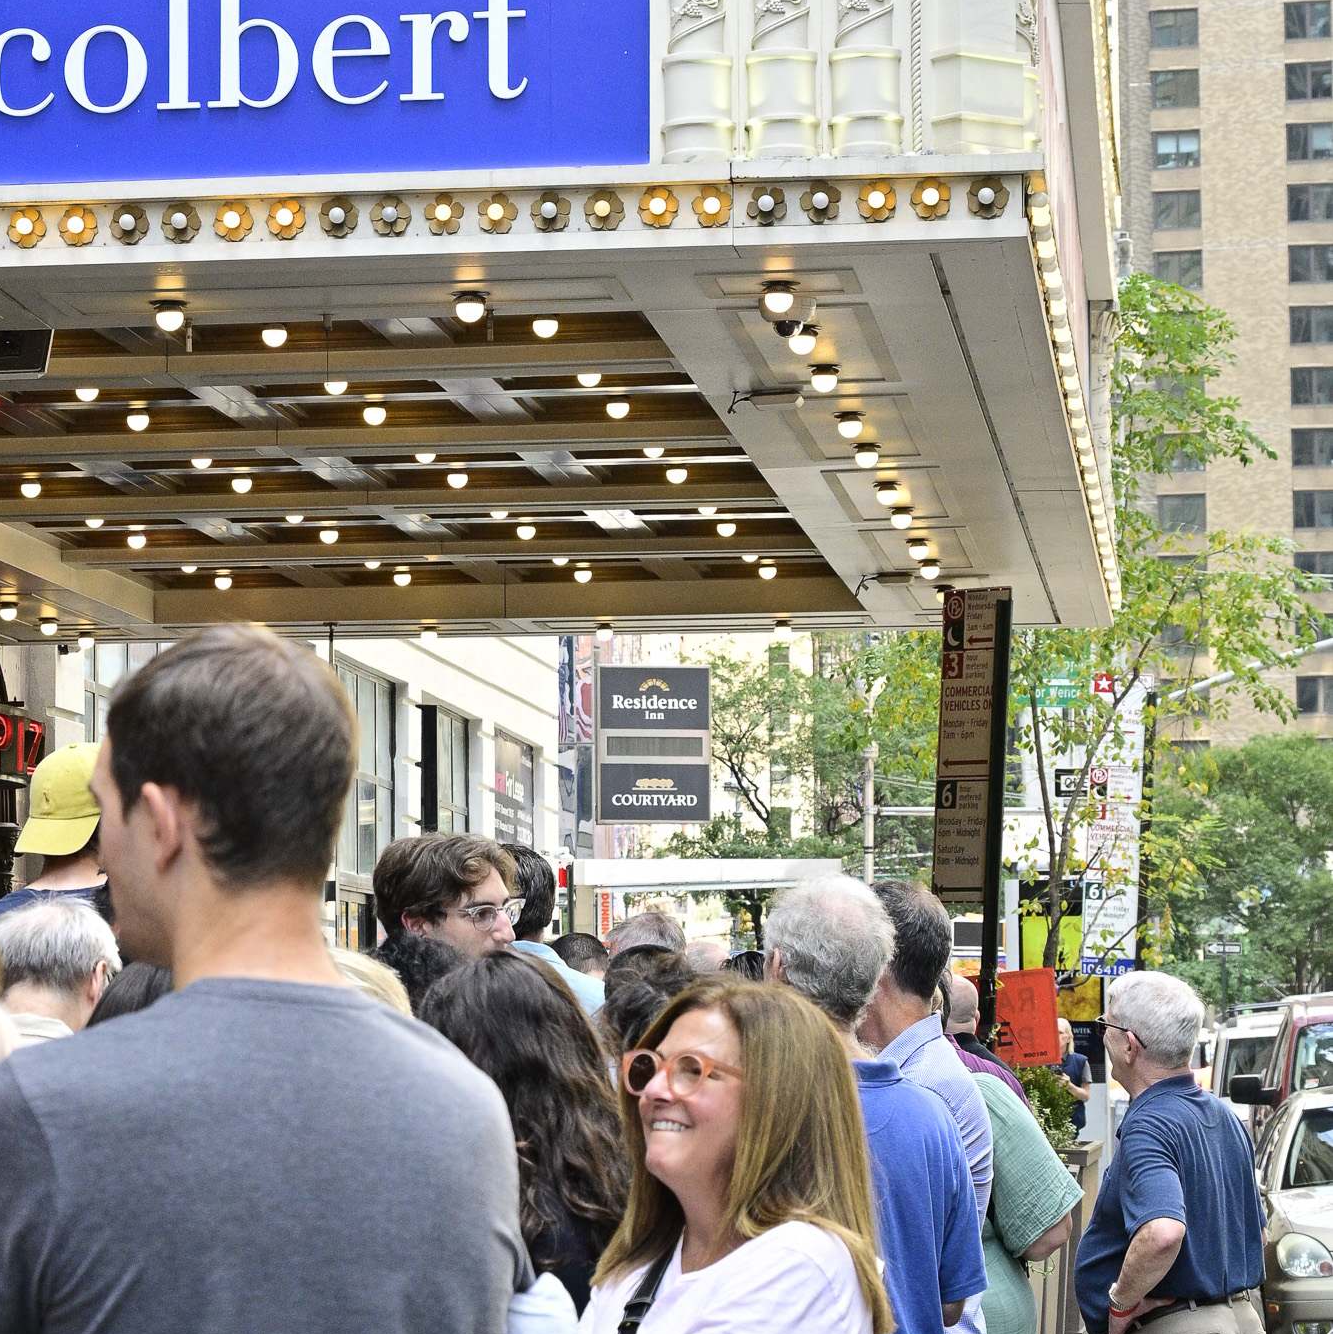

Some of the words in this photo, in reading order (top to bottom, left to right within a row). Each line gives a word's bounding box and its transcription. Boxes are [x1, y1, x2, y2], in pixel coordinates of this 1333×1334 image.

[948, 653, 959, 677] 3
[966, 662, 989, 670] metered
[965, 671, 986, 680] parking
[612, 694, 698, 709] Residence
[945, 699, 981, 712] VEHICLES
[645, 710, 665, 720] Inn
[943, 719, 965, 729] Monday
[970, 718, 989, 729] Friday
[612, 794, 698, 807] COURTYARD
[942, 783, 953, 807] 6
[959, 793, 982, 801] metered
[938, 817, 962, 827] Monday
[967, 816, 987, 827] Friday
[956, 827, 981, 839] Midnight
[937, 845, 964, 855] Saturday
[954, 855, 979, 866] Midnight
[1089, 883, 1100, 899] 6
